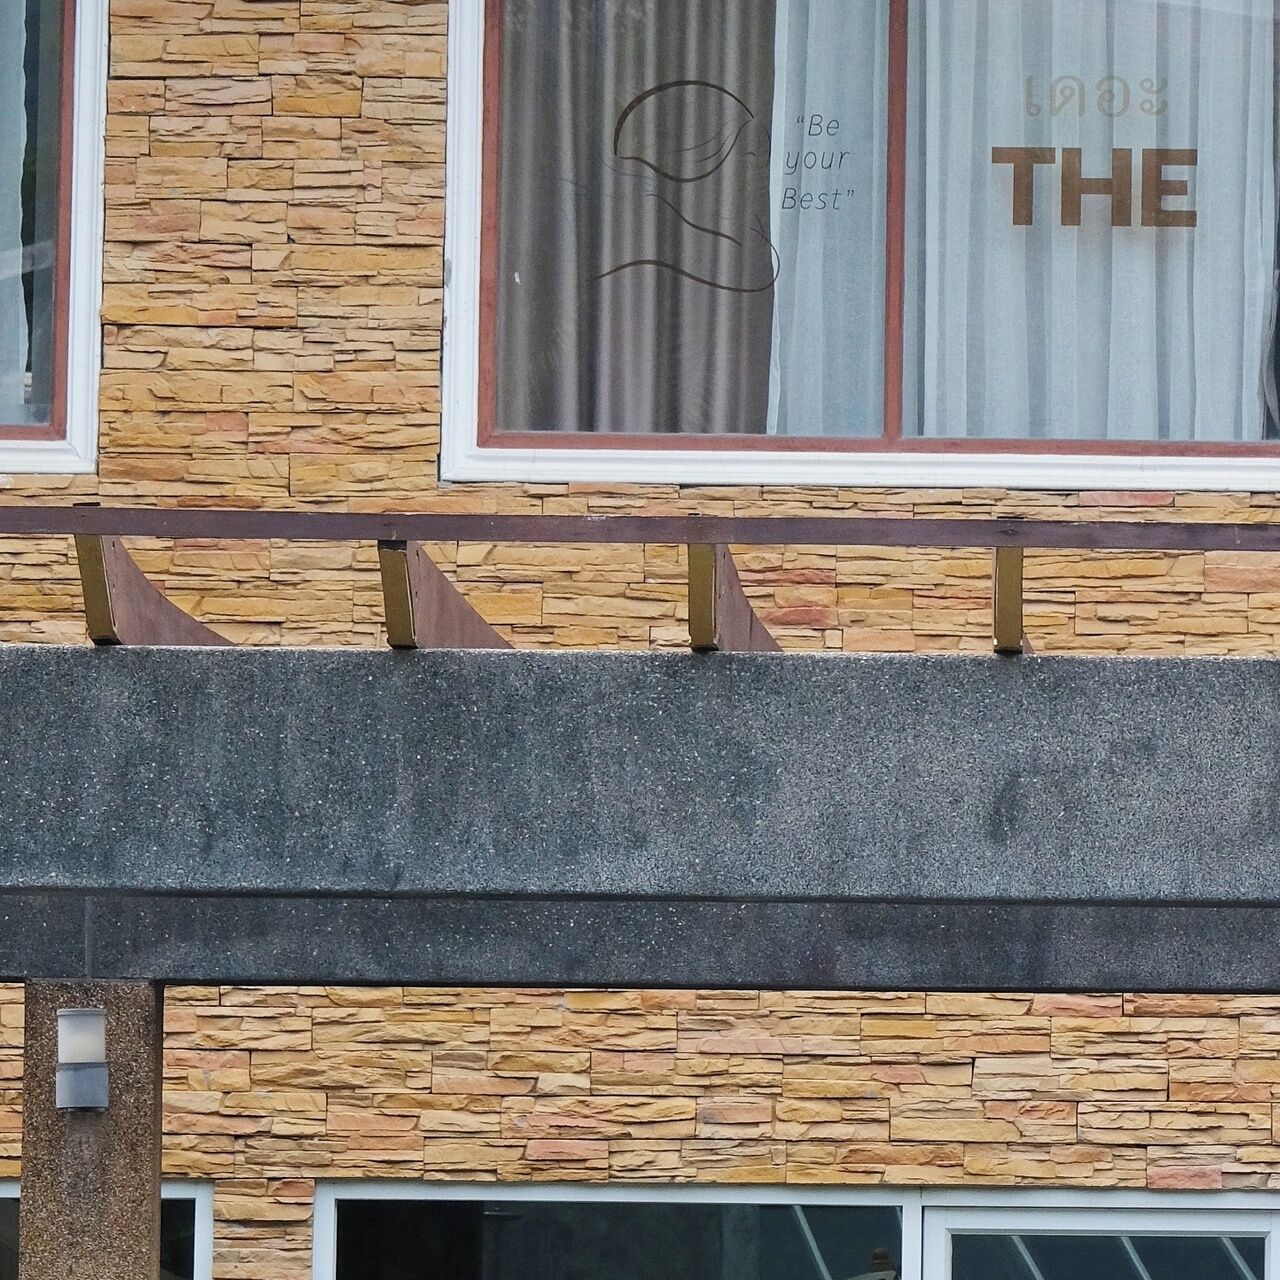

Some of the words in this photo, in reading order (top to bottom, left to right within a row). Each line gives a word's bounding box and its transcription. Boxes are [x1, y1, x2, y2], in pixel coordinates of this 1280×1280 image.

[1023, 74, 1169, 118] เดอะ
[784, 150, 851, 176] your
[991, 146, 1198, 228] THE
